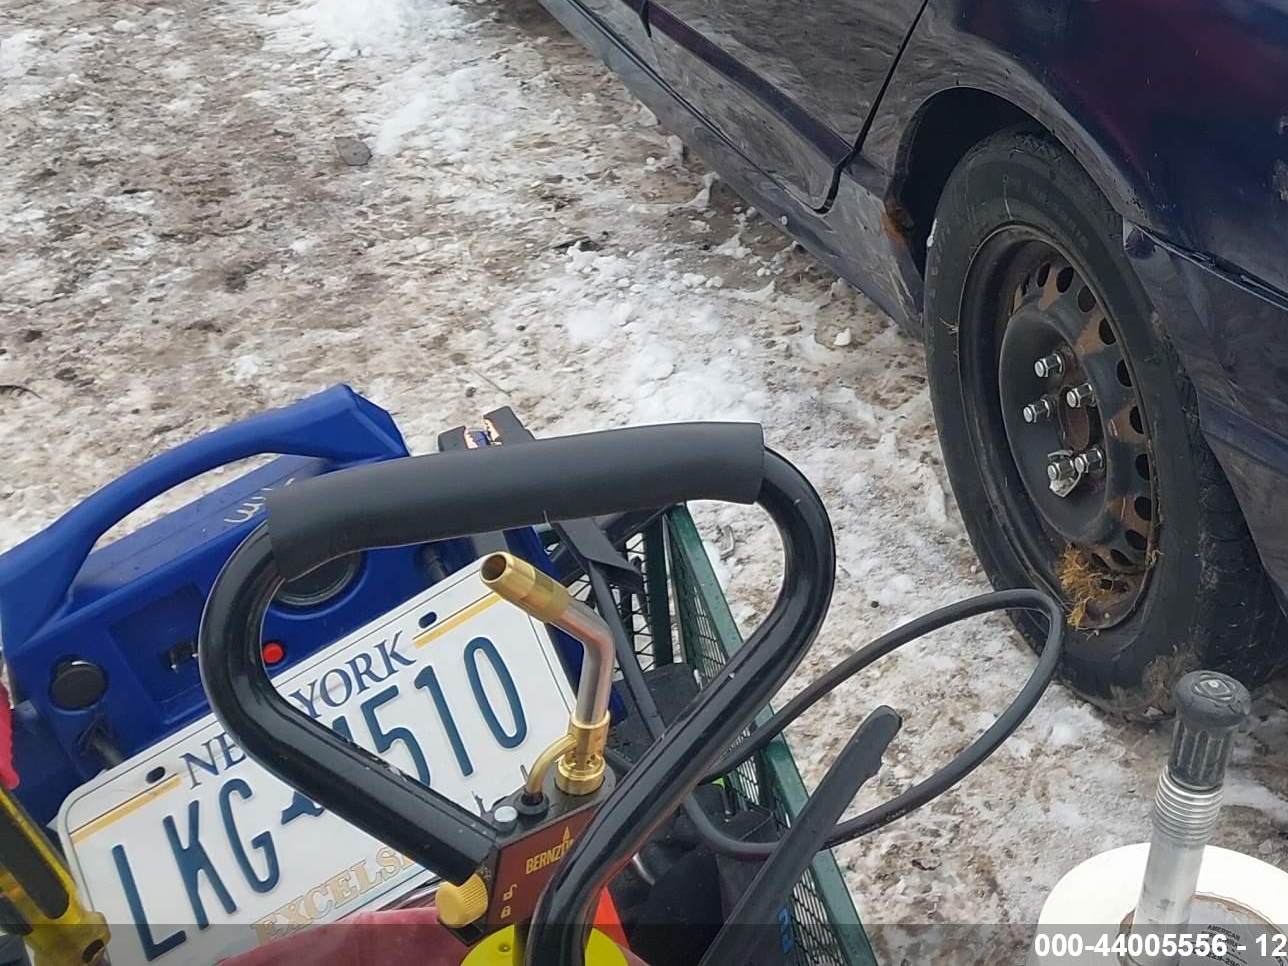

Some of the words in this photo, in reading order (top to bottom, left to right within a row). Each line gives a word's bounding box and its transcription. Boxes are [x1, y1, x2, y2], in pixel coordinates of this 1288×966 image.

[111, 777, 281, 963] LKG
[331, 636, 529, 788] 510
[179, 732, 249, 791] NE
[289, 630, 417, 719] YORK
